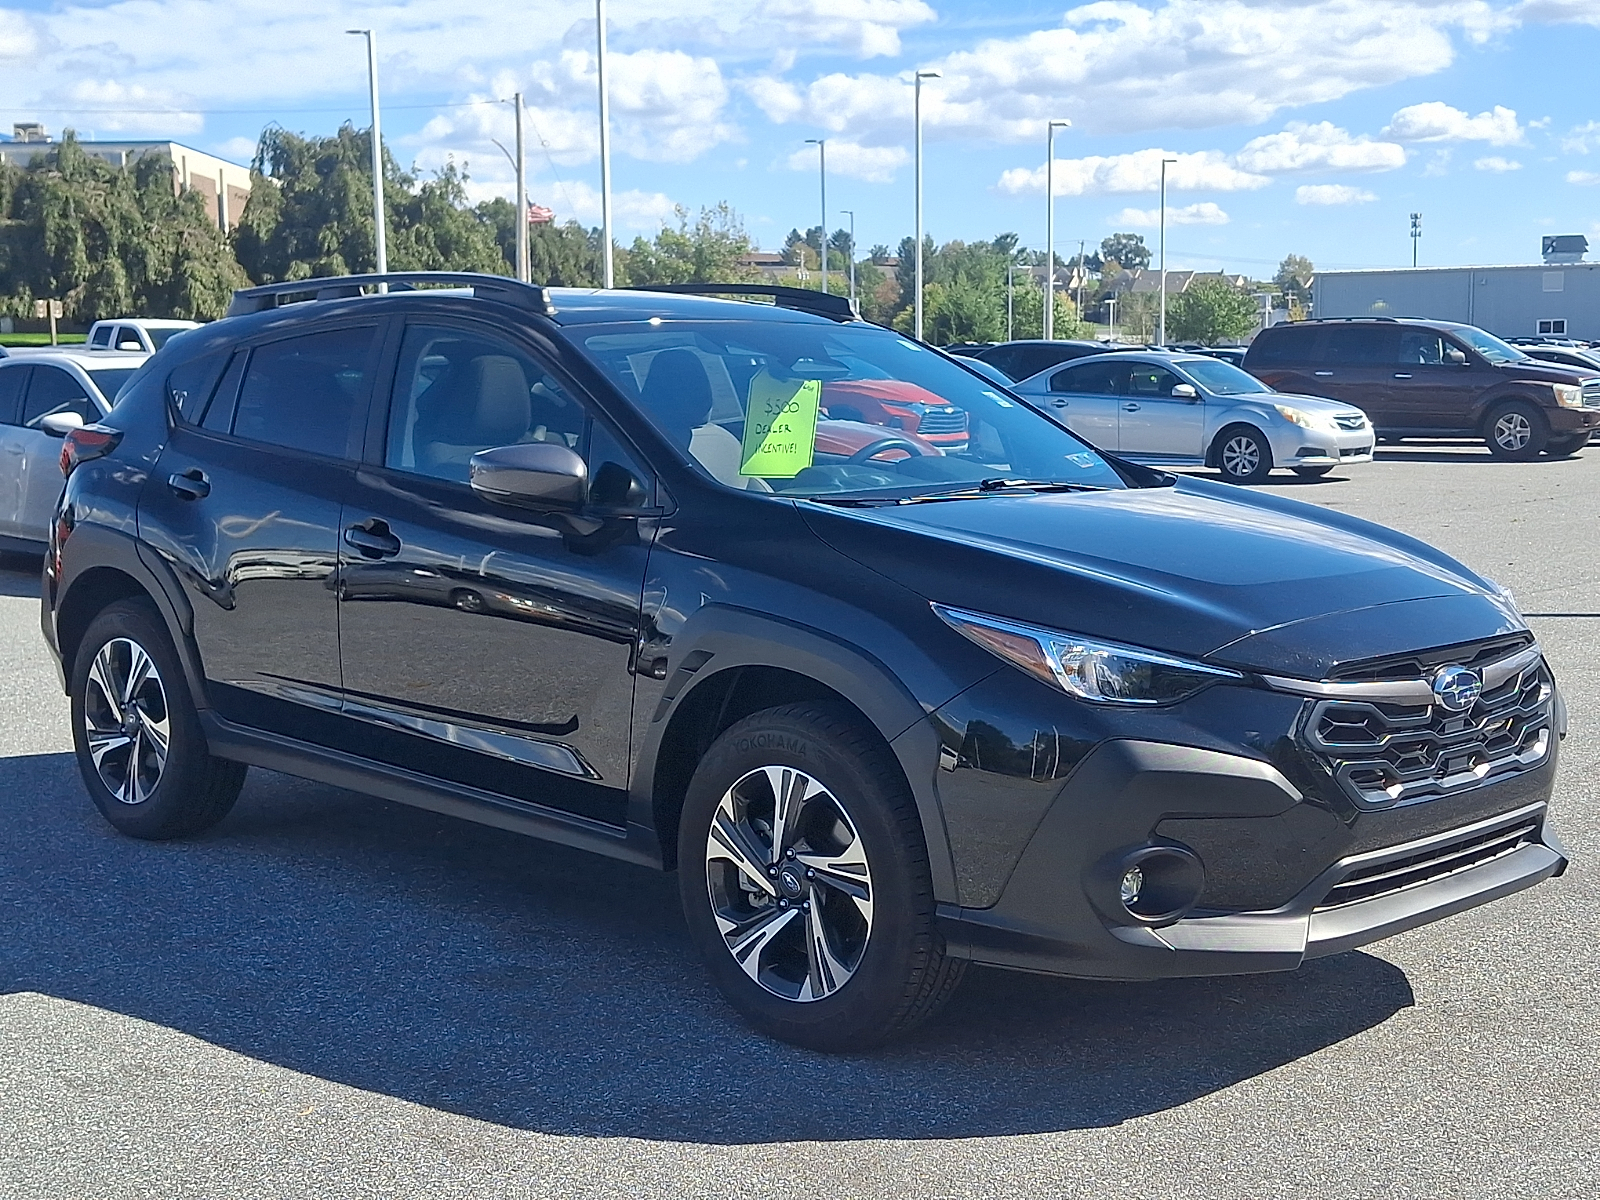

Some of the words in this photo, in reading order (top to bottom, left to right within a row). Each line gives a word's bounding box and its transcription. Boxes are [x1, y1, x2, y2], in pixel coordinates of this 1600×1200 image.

[764, 397, 800, 416] $500
[755, 423, 792, 435] DEALER
[755, 442, 797, 454] INCENTIVE!
[733, 733, 807, 756] YOKOHAMA
